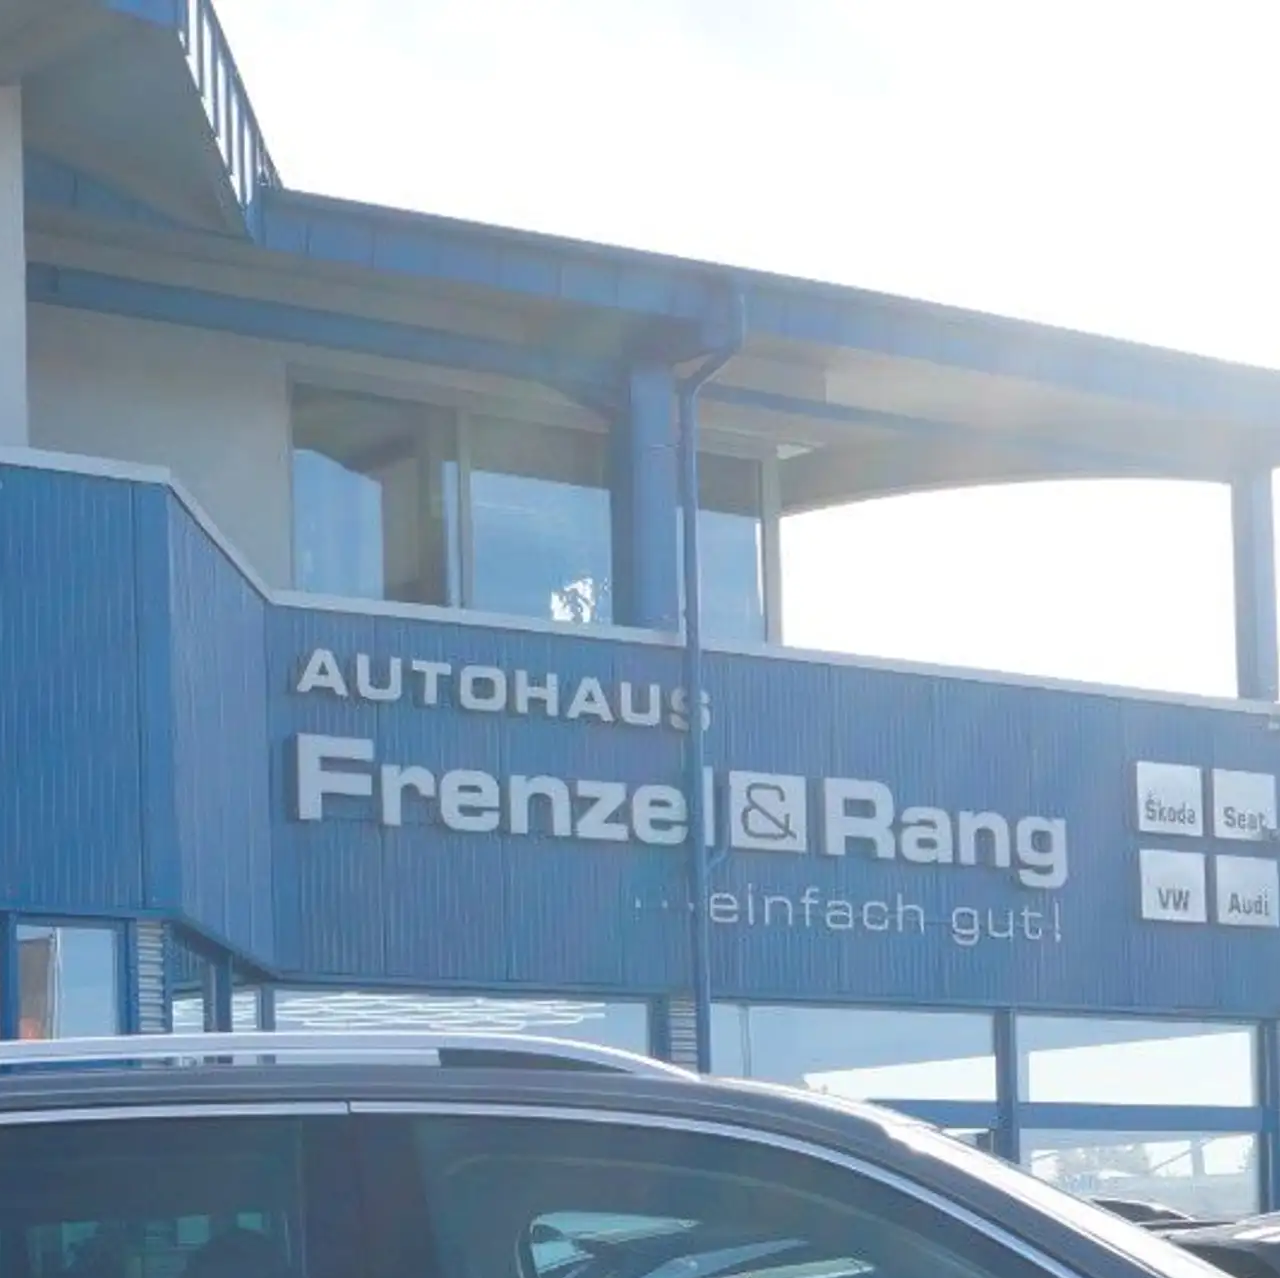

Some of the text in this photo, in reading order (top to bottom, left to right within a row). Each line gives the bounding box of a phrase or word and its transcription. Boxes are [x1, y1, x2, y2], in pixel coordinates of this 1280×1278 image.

[296, 648, 711, 732] AUTOHAUS
[296, 732, 715, 847] Frenzel
[823, 776, 1070, 889] Rang
[1144, 796, 1196, 825] Škoda
[1222, 806, 1266, 830] Seat
[1157, 887, 1191, 912] VW
[1228, 892, 1270, 917] Audi
[951, 898, 1062, 947] gut!
